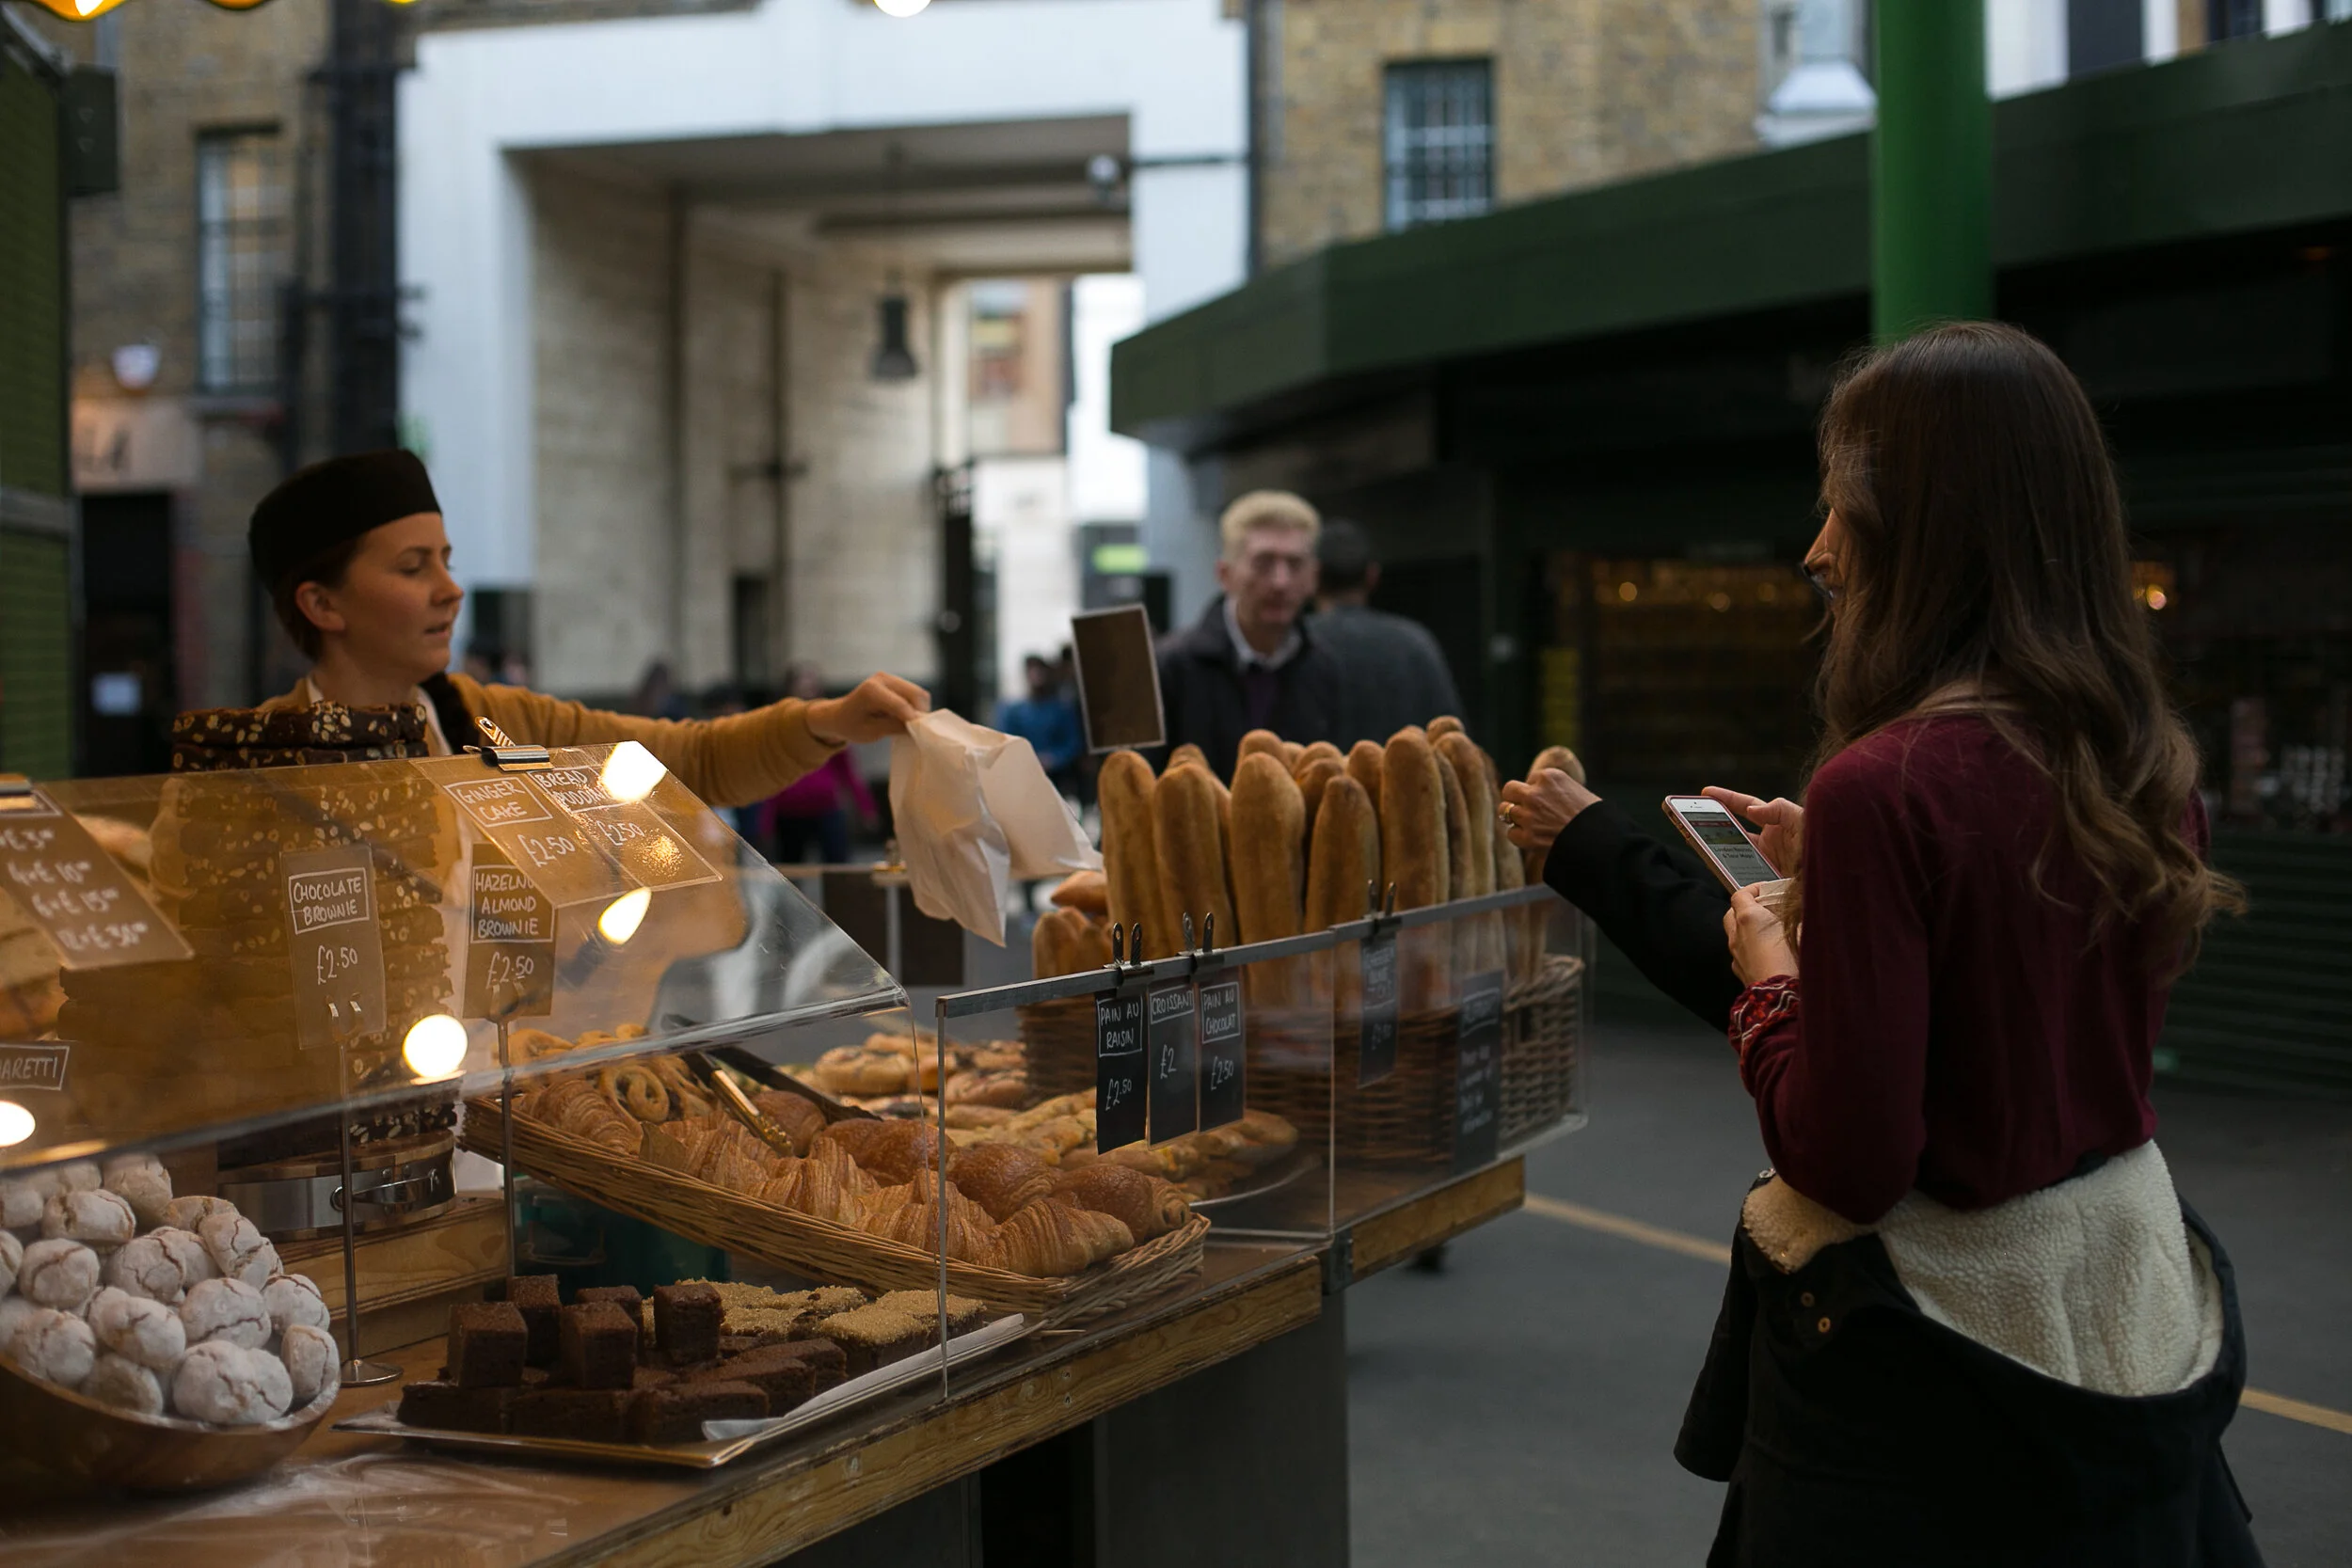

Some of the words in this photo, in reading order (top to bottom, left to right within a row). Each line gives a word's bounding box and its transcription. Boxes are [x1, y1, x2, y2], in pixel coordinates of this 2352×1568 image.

[534, 770, 588, 788] BREAD
[457, 780, 525, 804] GINGER
[552, 787, 612, 806] PUDDIN
[478, 801, 527, 822] CAKE
[516, 834, 576, 868] £2.50
[294, 877, 361, 903] CHOCOLATE
[475, 871, 535, 893] HAZELNU
[303, 899, 358, 926] BROWNIE
[482, 895, 537, 915] ALMOND
[478, 918, 539, 939] BROWNIE
[317, 944, 358, 985] £2.50
[485, 951, 534, 990] £2.50
[1152, 990, 1193, 1015] CROISSANT
[1203, 991, 1221, 1012] PAIN
[1100, 1006, 1121, 1026] PAIN
[1126, 1002, 1139, 1020] AU
[1106, 1027, 1134, 1050] RAISIN
[0, 1056, 57, 1080] ARETTI
[1160, 1044, 1177, 1080] £2
[1105, 1078, 1133, 1111] £2.50
